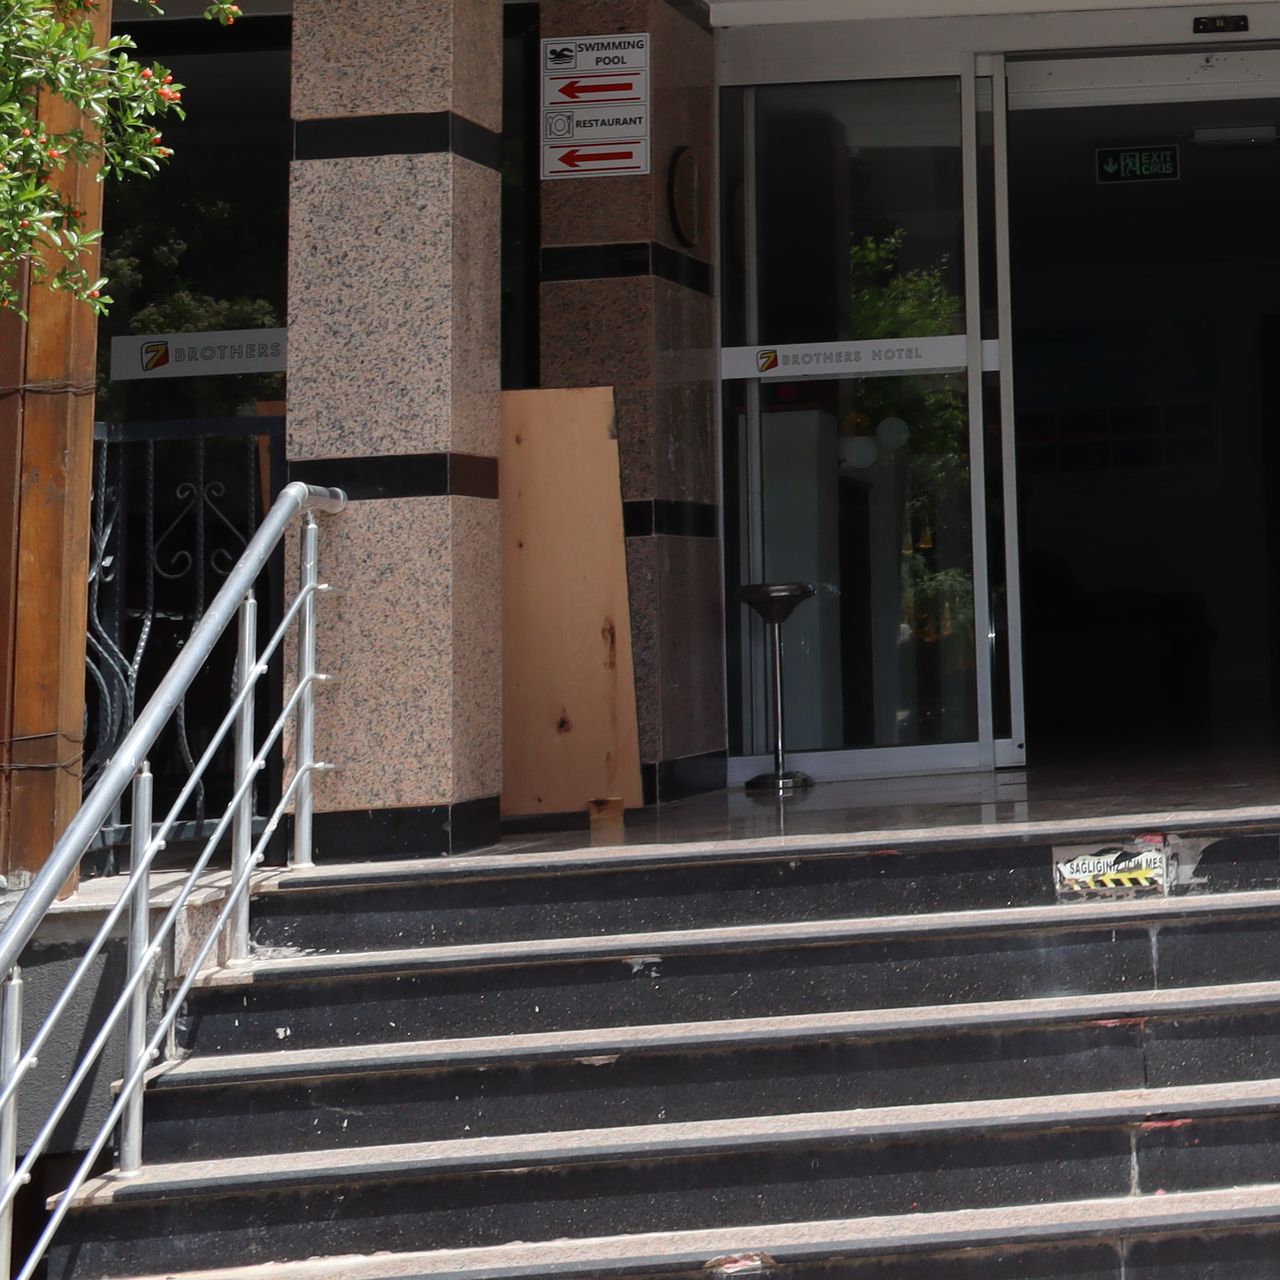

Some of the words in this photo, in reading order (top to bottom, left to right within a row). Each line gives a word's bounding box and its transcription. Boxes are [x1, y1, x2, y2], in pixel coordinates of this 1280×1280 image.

[577, 39, 645, 53] SWIMMING
[595, 55, 627, 66] POOL
[575, 116, 644, 128] RESTAURANT
[1141, 151, 1173, 163] EXIT
[174, 342, 281, 362] BROTHERS
[781, 350, 863, 366] BROTHERS
[871, 347, 922, 361] HOTEL
